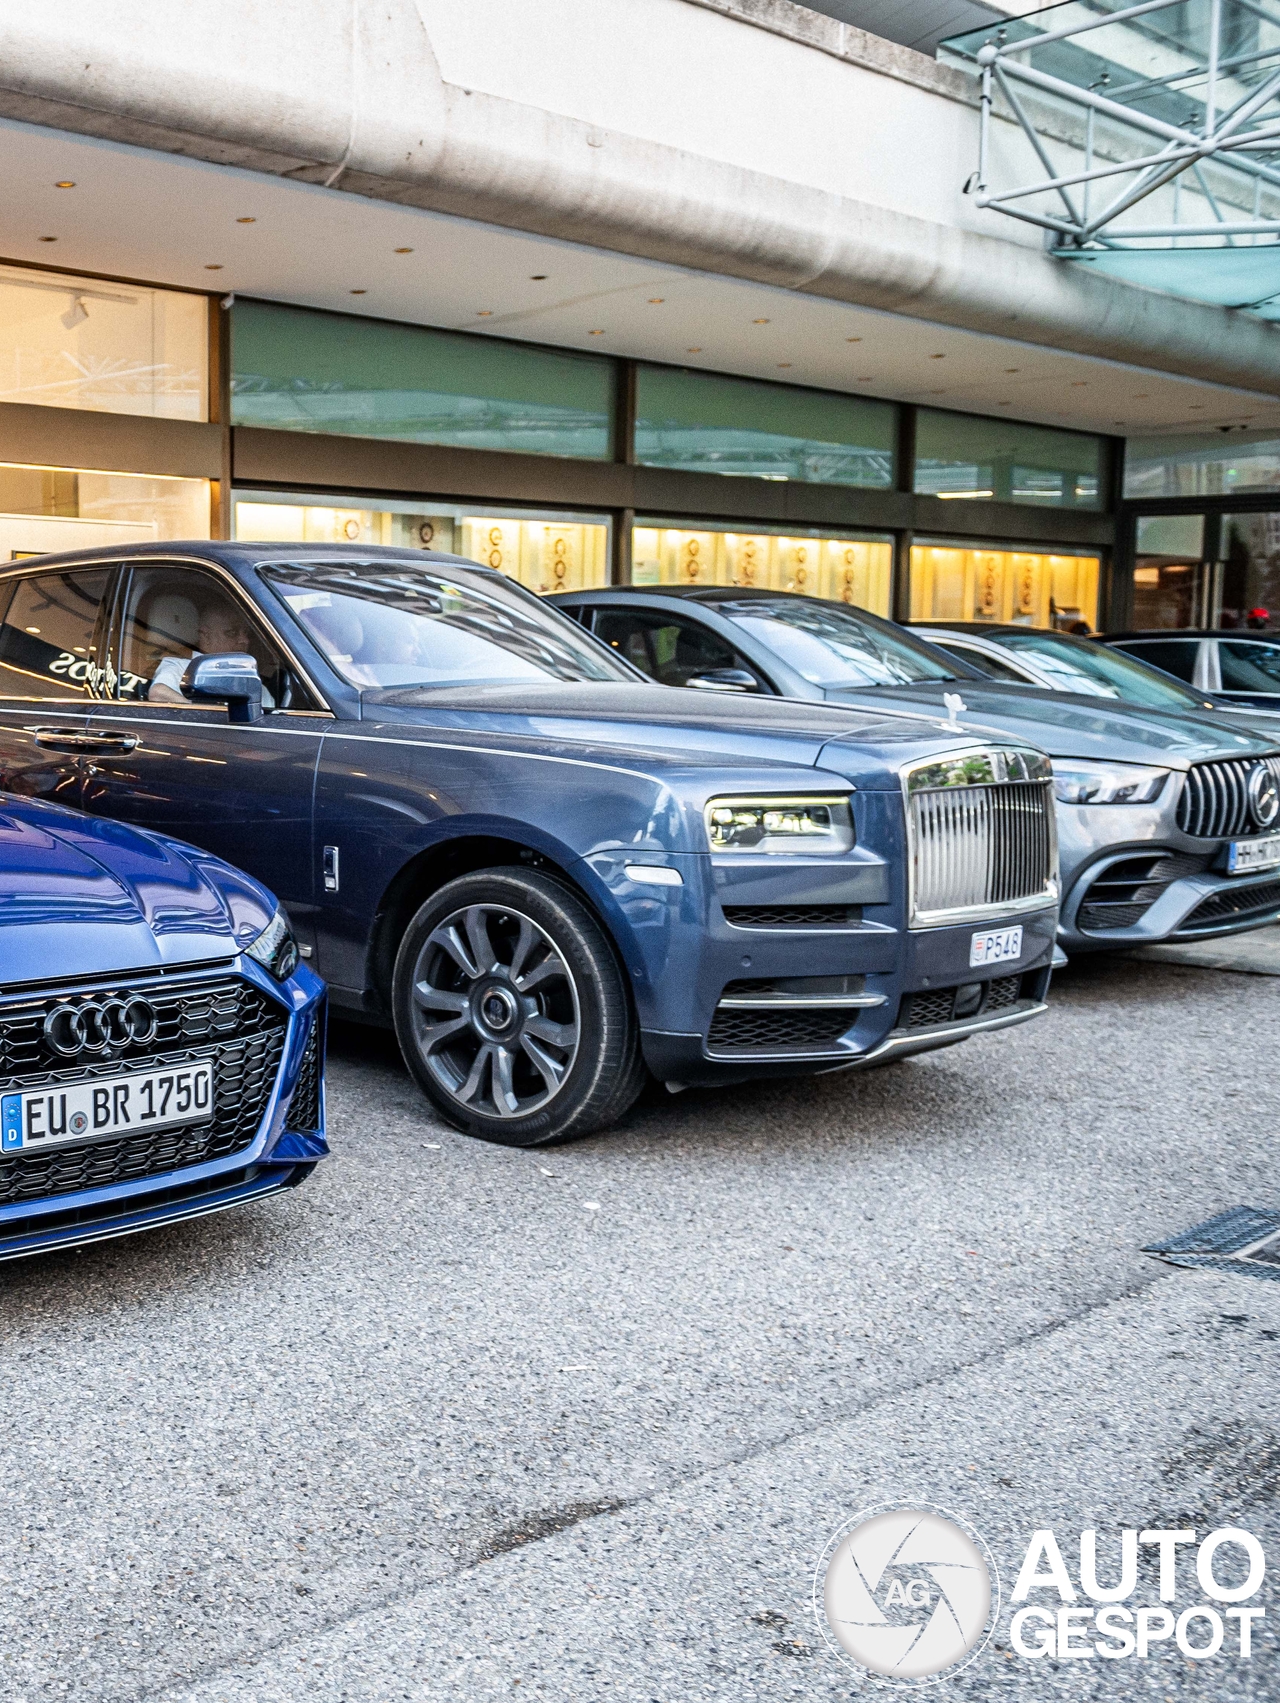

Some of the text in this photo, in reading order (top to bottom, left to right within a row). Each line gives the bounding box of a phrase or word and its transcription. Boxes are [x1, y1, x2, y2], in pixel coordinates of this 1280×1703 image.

[985, 932, 1019, 960] P548
[8, 1070, 209, 1142] D EU BR 1750
